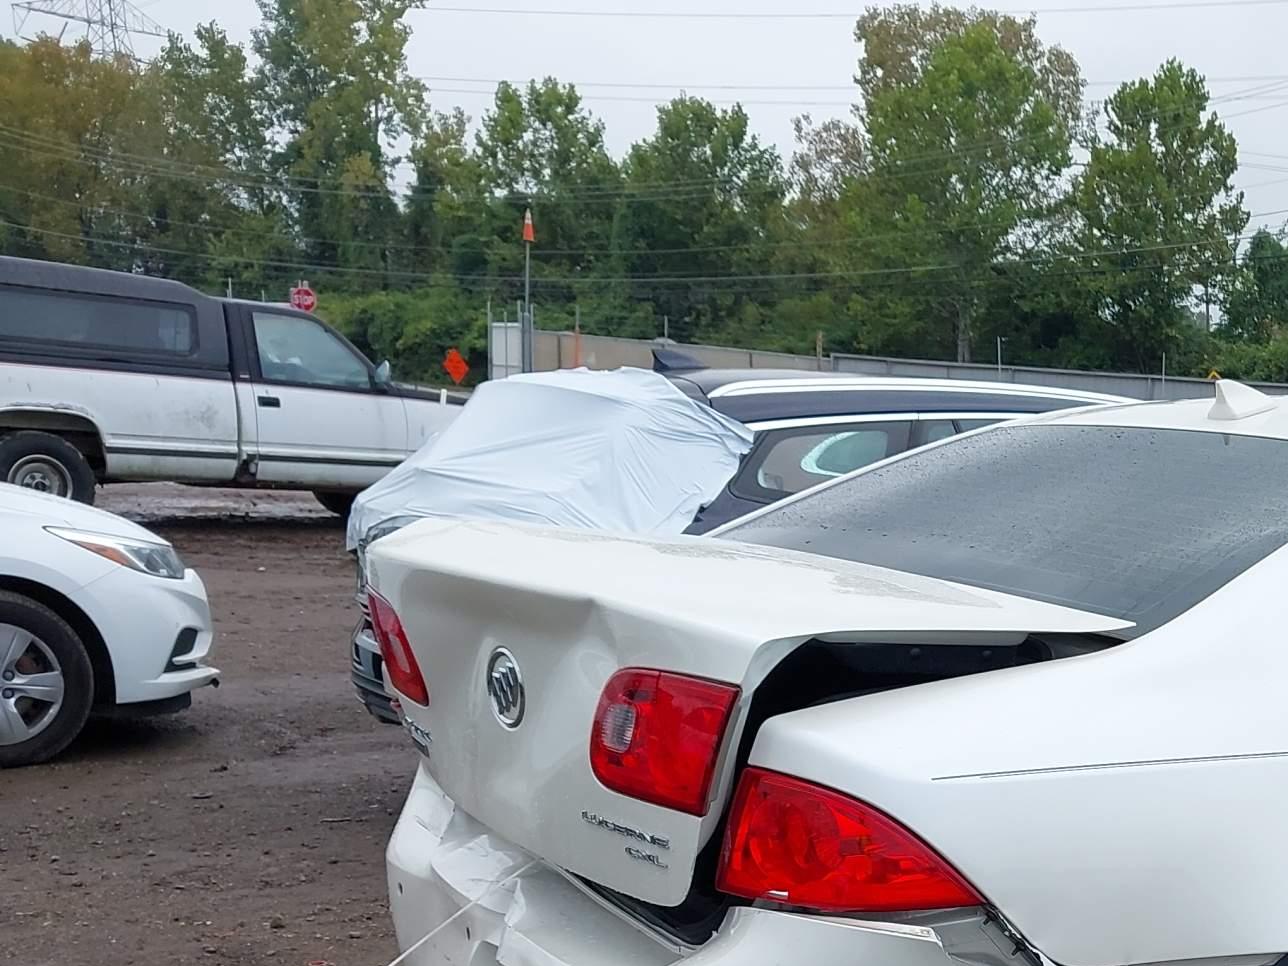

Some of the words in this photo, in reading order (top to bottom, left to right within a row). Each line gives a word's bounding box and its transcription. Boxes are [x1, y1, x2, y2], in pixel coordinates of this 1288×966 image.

[293, 294, 314, 305] STOP
[581, 810, 670, 850] LUCERNE
[624, 847, 669, 870] CXL
